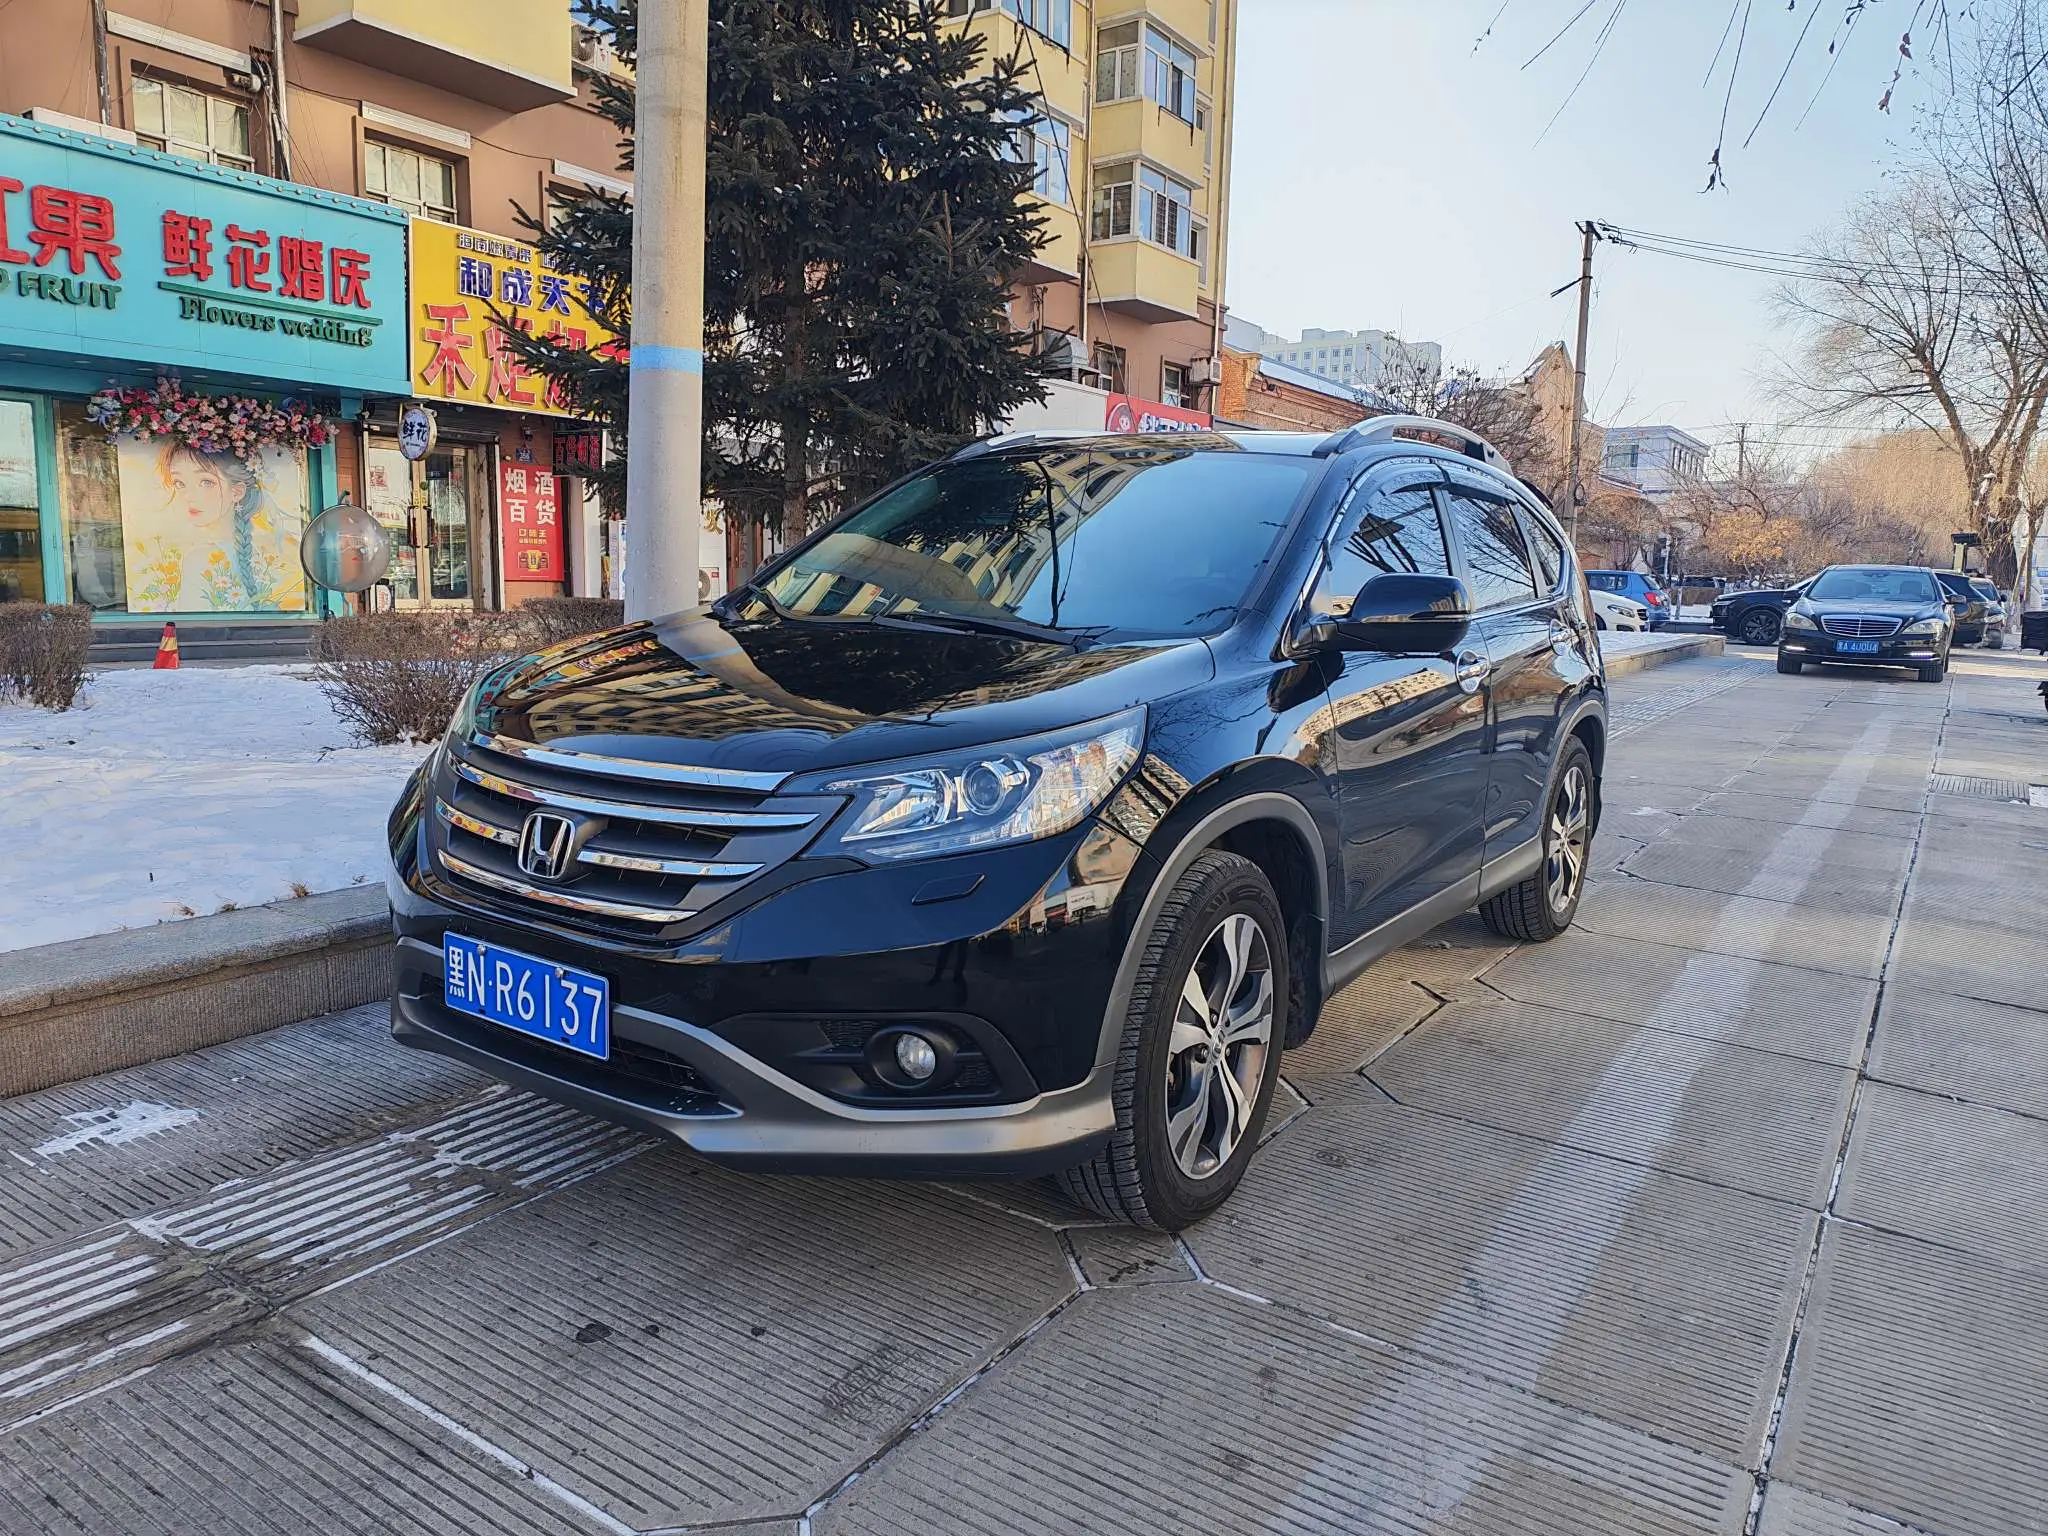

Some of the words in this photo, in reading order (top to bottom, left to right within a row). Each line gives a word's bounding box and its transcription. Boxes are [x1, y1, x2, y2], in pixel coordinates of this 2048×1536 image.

[163, 210, 372, 308] 鲜花婚庆
[18, 270, 122, 310] FRUIT
[180, 296, 276, 332] Flowers
[280, 317, 373, 348] wedding
[403, 420, 427, 442] 鲜花
[505, 467, 555, 496] 烟酒
[506, 498, 556, 525] 百货
